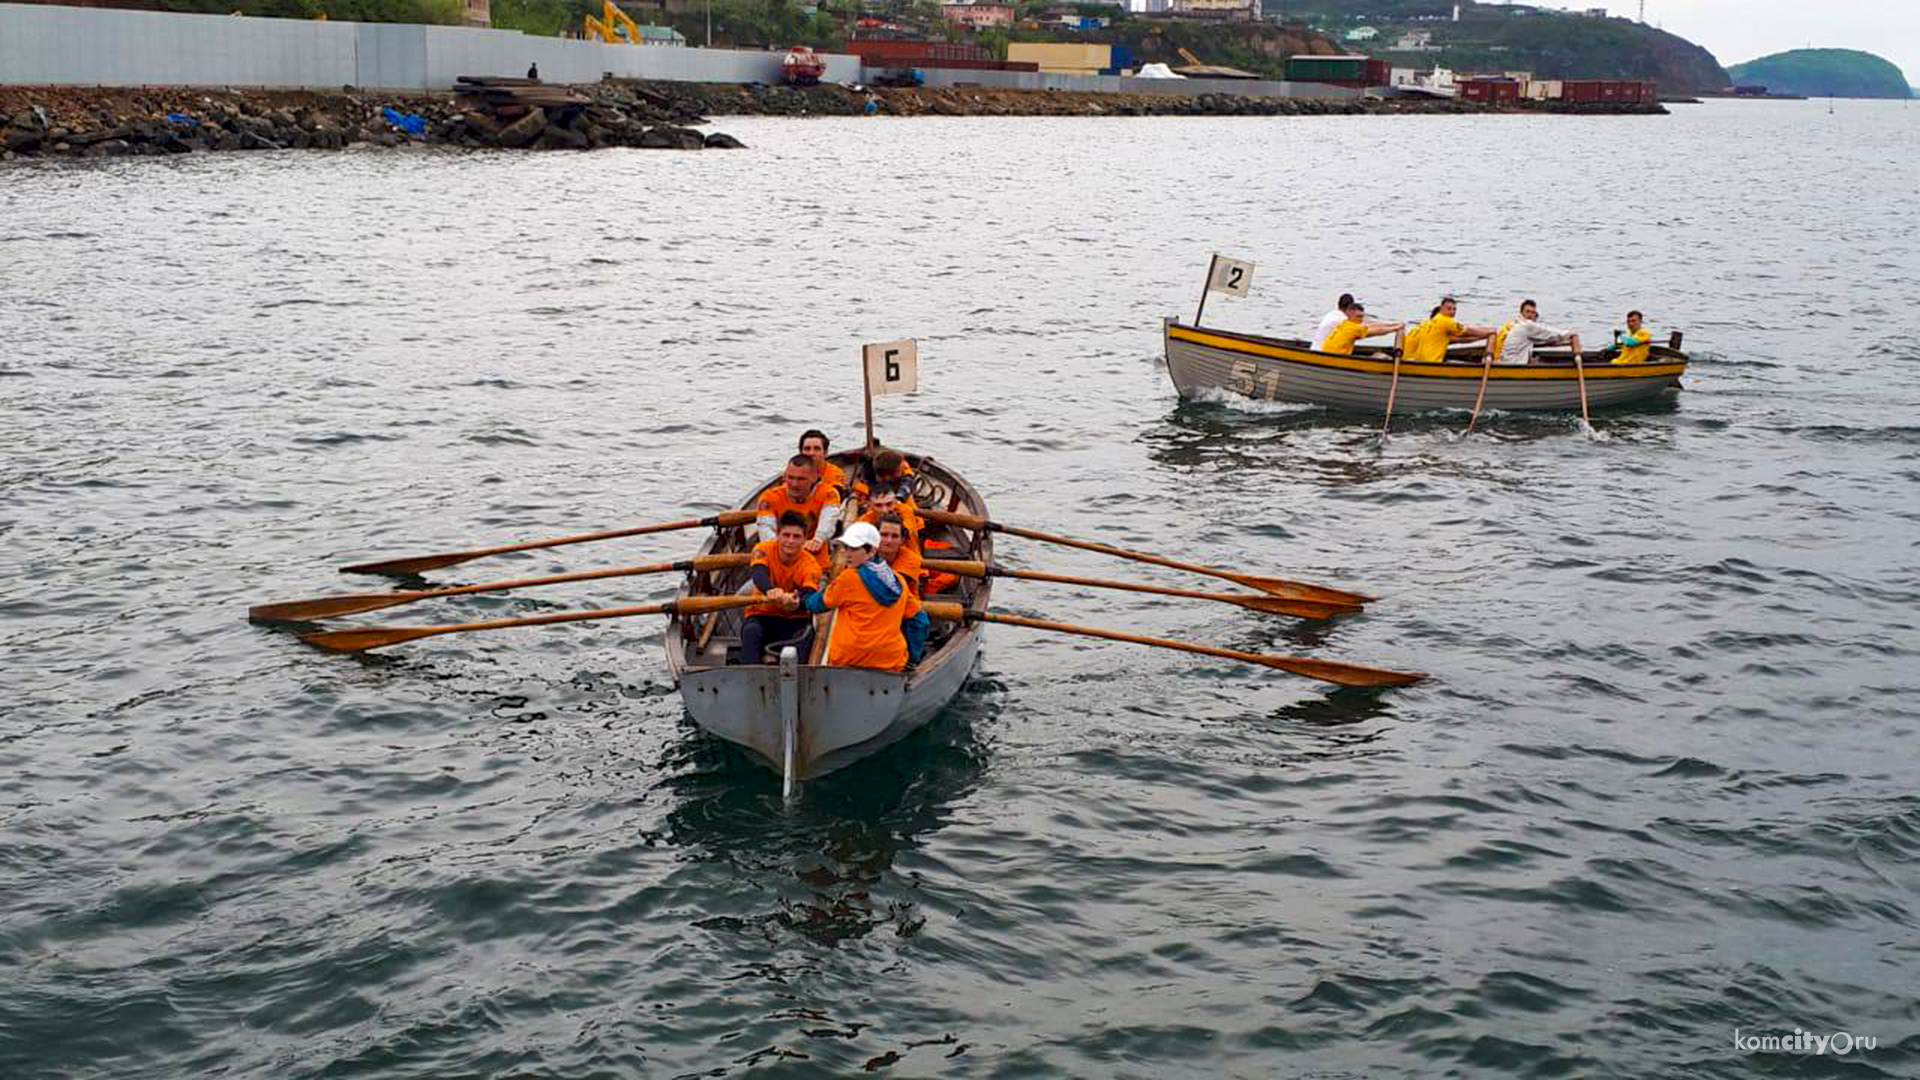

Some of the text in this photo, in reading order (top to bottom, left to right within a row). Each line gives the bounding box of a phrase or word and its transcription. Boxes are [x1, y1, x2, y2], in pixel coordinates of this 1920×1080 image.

[1228, 266, 1244, 290] 2
[885, 349, 900, 382] 6
[1224, 359, 1280, 401] 51
